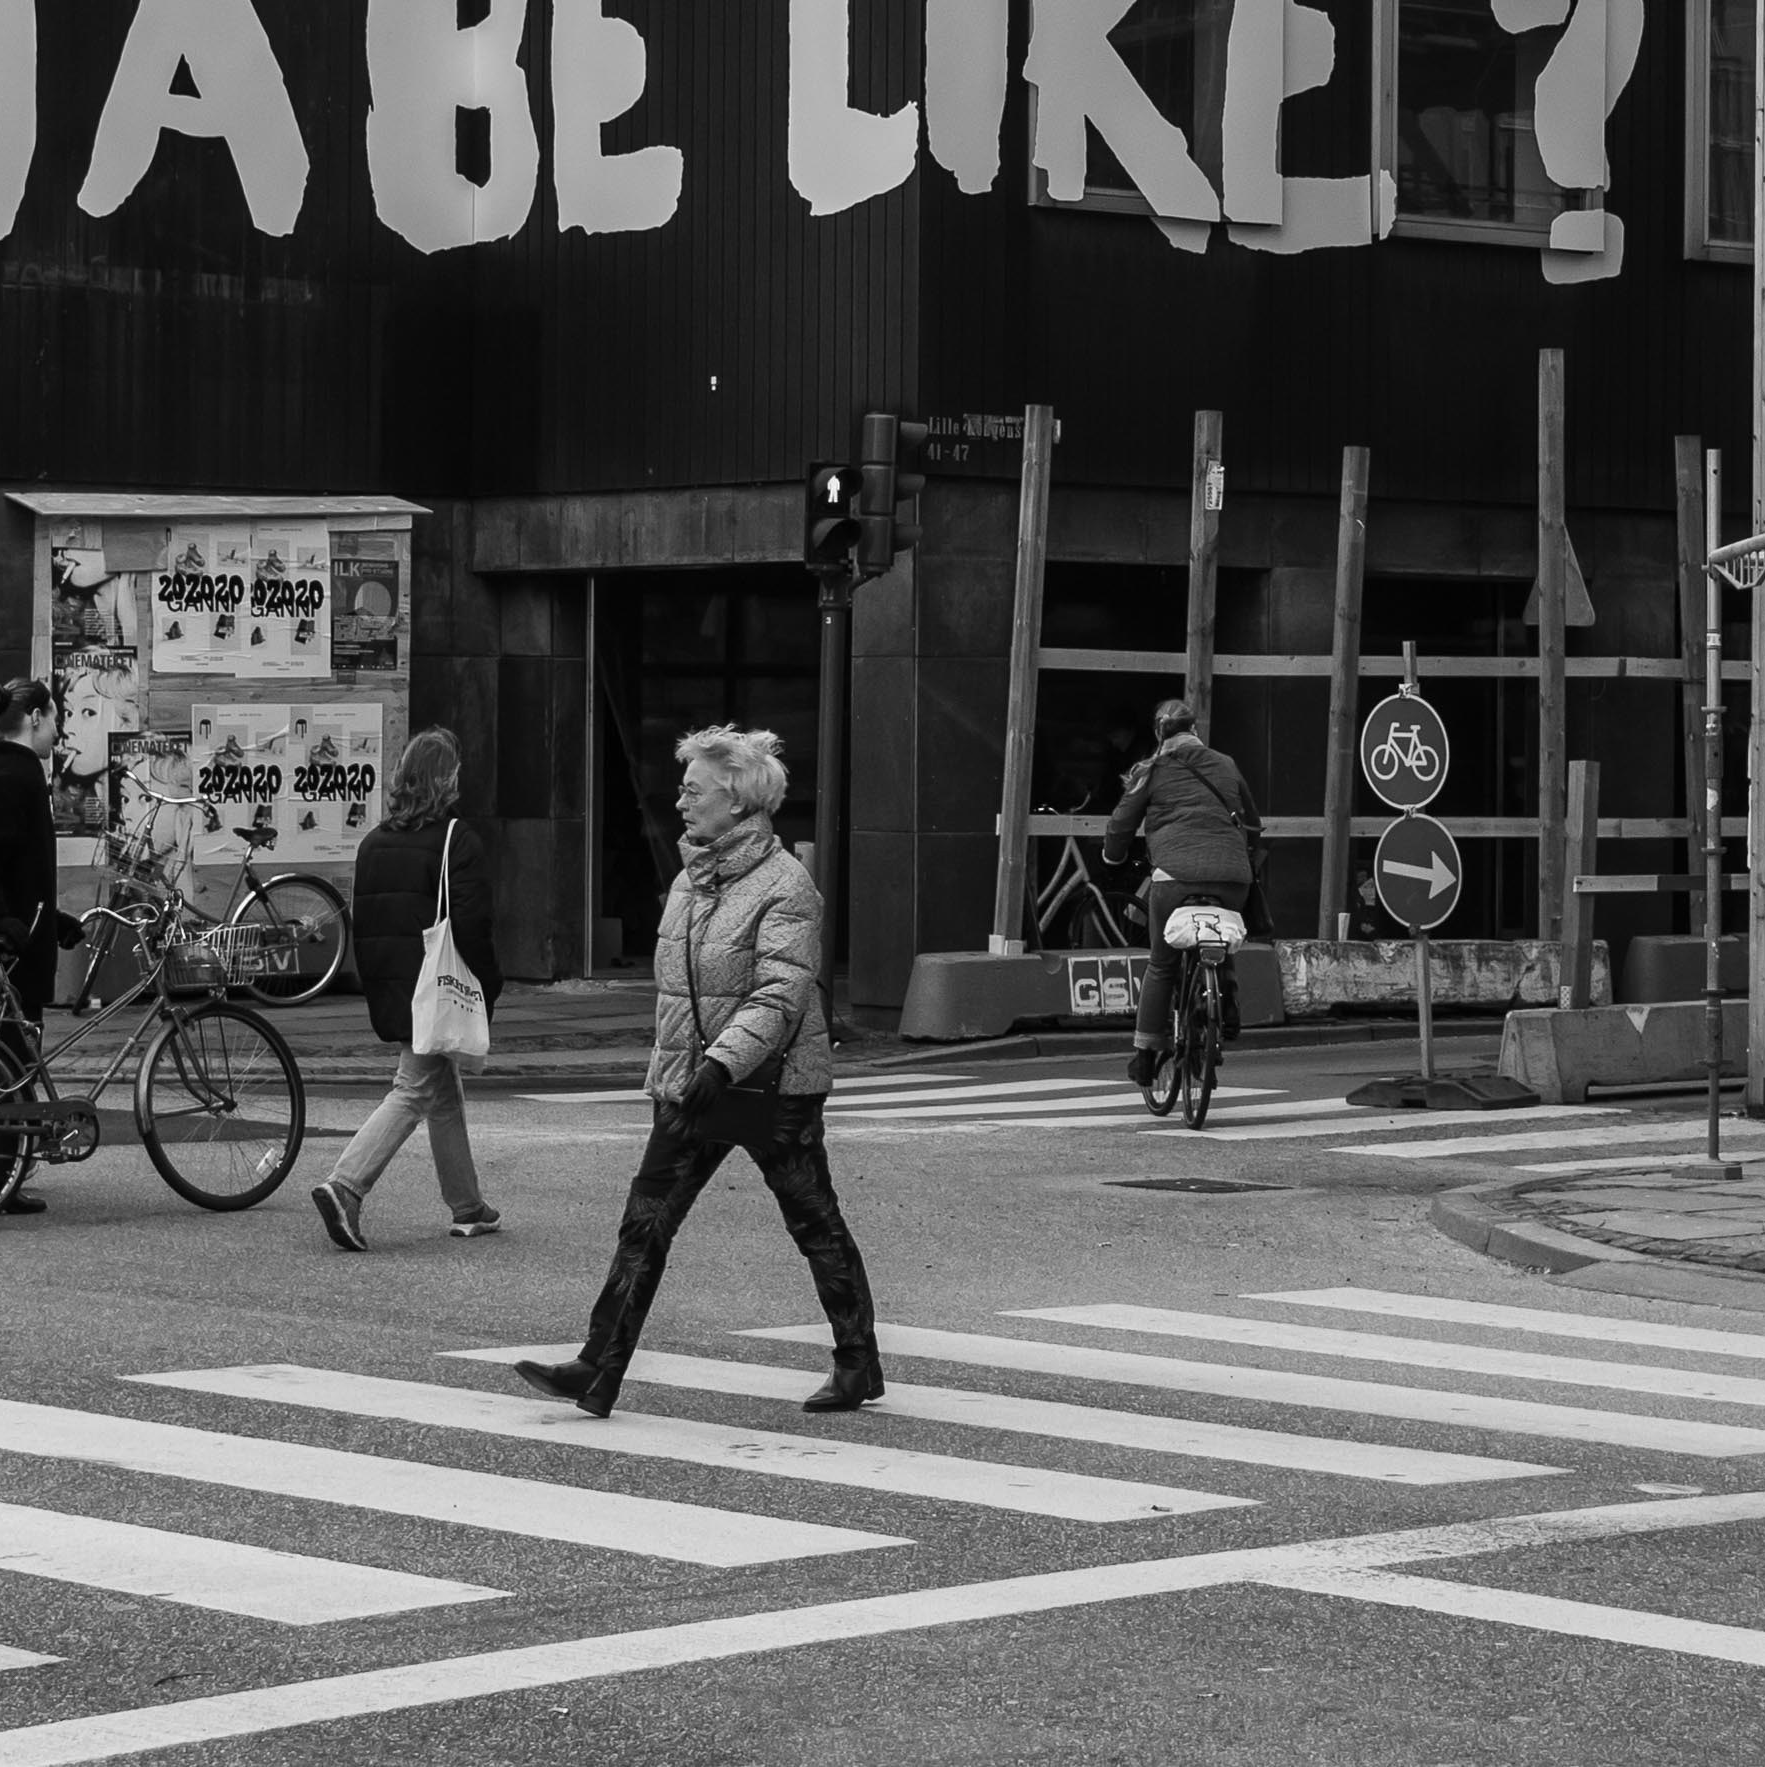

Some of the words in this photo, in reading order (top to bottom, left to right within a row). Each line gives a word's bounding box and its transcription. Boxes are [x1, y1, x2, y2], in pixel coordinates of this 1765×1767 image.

[929, 416, 960, 435] Lille
[334, 562, 360, 577] ILK
[158, 574, 244, 602] 202020
[251, 580, 324, 609] 02020
[54, 652, 133, 669] CINEMATEKET
[111, 739, 189, 755] CINEMATEKET
[199, 764, 282, 794] 202020
[294, 764, 375, 793] 202020
